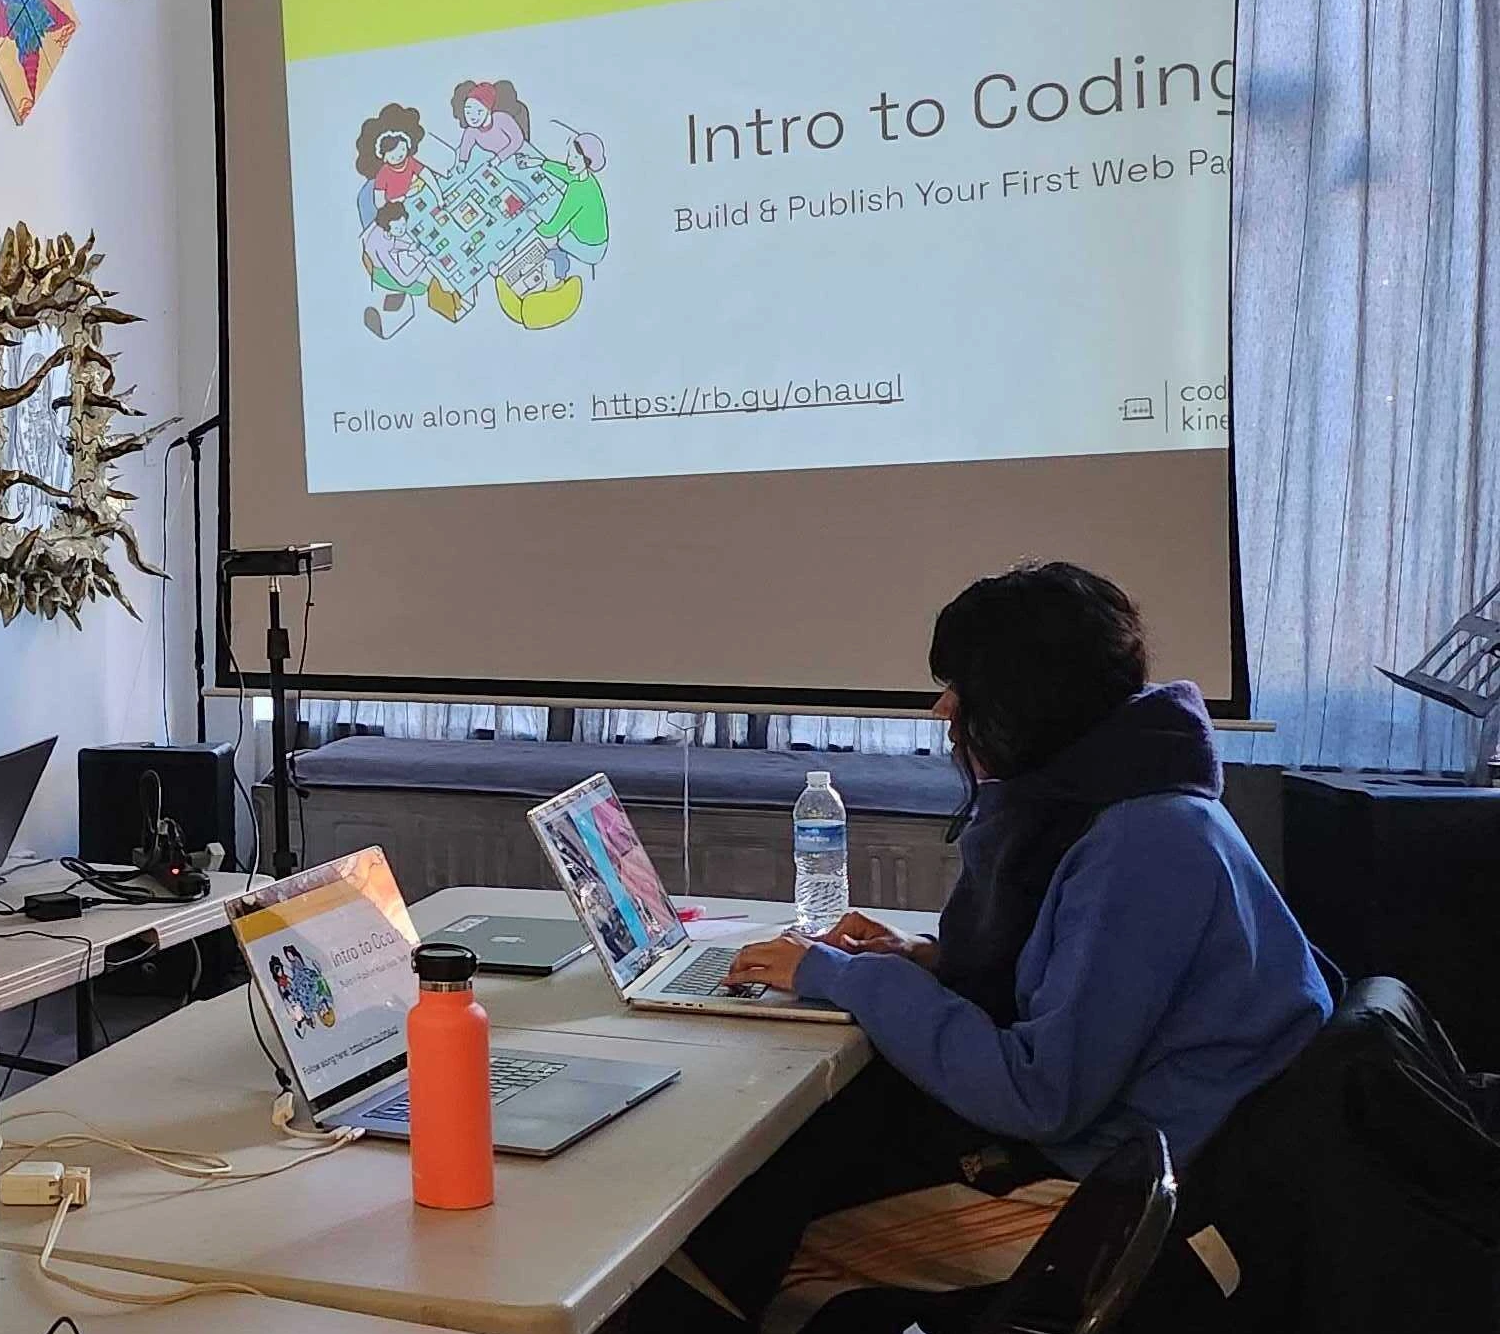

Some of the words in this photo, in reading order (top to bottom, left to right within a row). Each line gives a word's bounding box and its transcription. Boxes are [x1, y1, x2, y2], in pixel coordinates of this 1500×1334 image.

[687, 108, 844, 165] Intro
[868, 91, 945, 141] to
[674, 200, 748, 233] Build
[759, 198, 778, 223] &
[788, 185, 904, 221] Publish
[914, 180, 990, 207] Your
[1002, 165, 1080, 198] First
[1092, 154, 1174, 187] Web
[1188, 149, 1232, 176] Pa
[332, 409, 414, 434] Follow
[422, 404, 496, 430] along
[506, 400, 575, 423] here:
